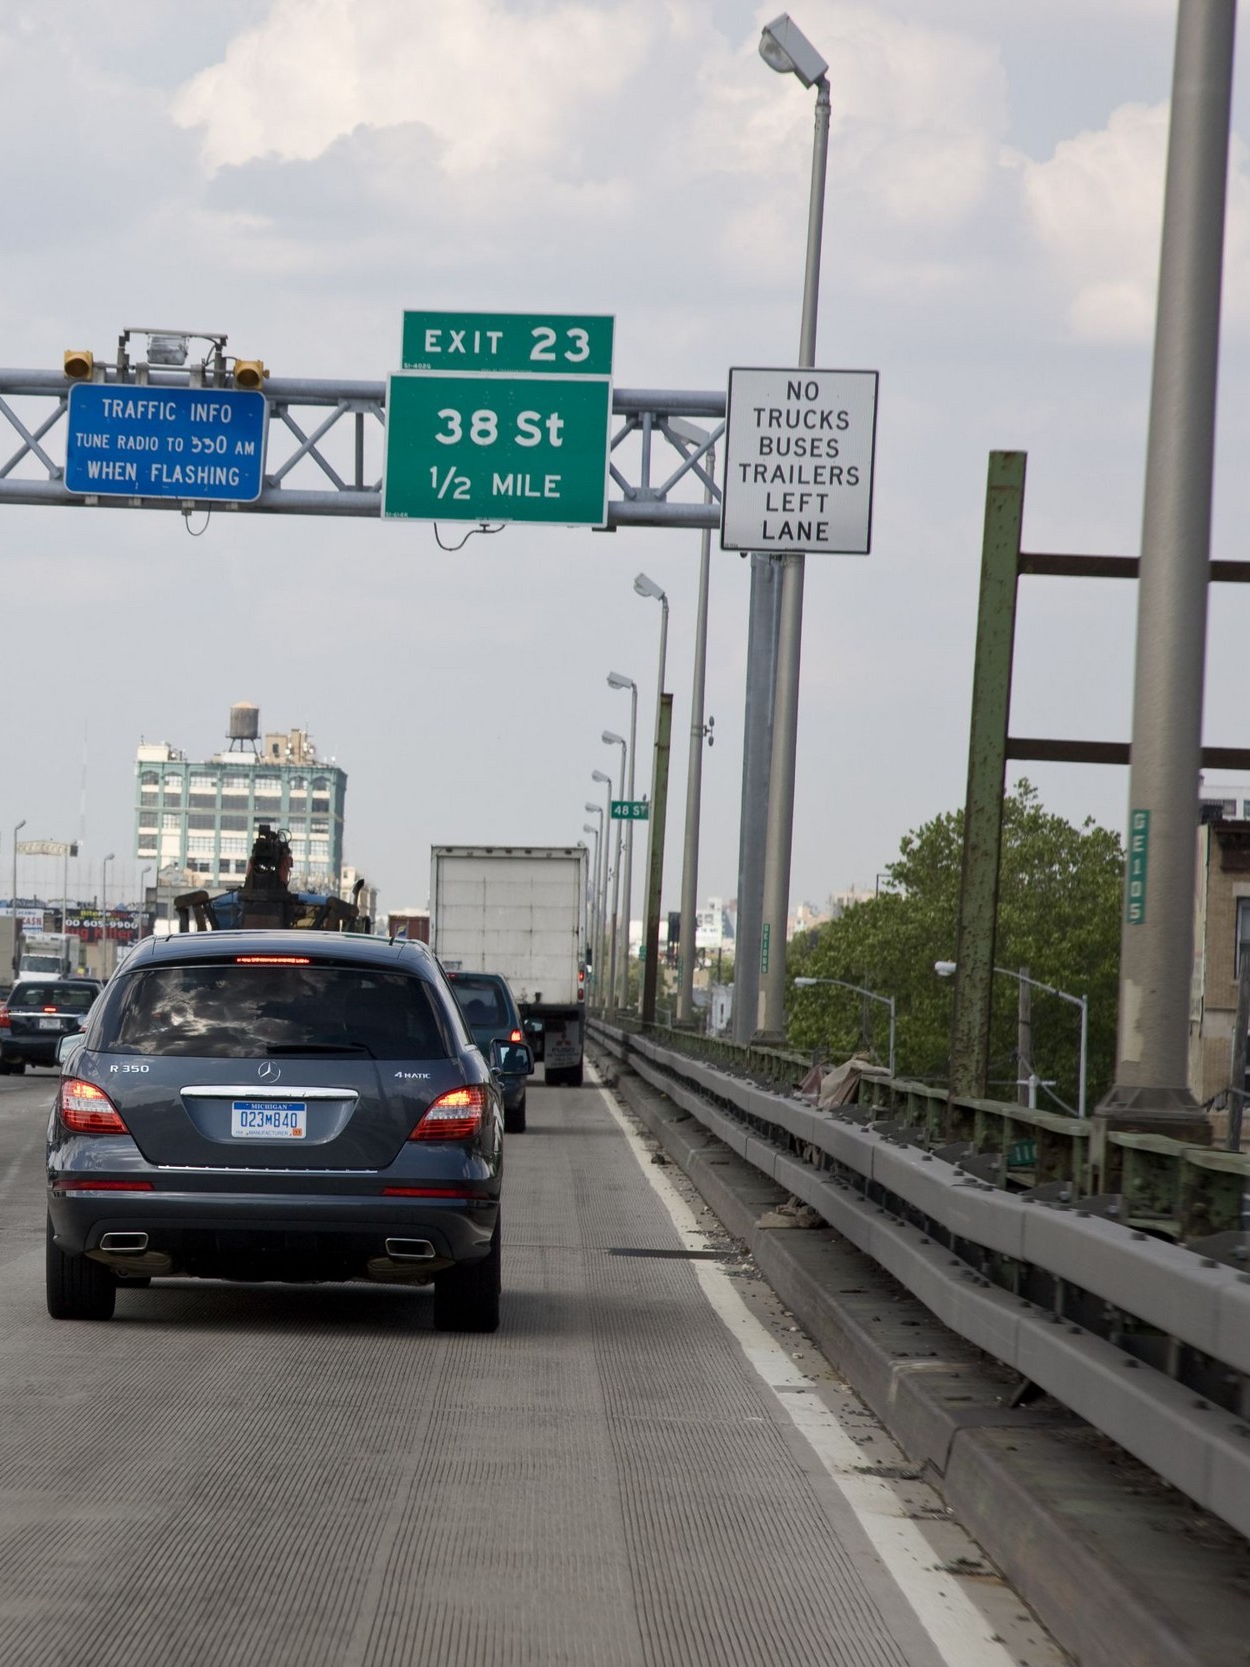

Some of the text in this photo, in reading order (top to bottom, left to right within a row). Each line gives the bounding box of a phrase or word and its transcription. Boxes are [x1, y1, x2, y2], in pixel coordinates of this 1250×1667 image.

[424, 326, 591, 362] EXIT 23
[787, 380, 819, 402] NO
[102, 399, 232, 424] TRAFFIC INFO
[753, 408, 850, 431] TRUCKS
[434, 408, 564, 447] 38 St
[76, 433, 110, 449] TUNE
[117, 434, 159, 451] RADIO
[167, 437, 183, 452] TO
[235, 440, 255, 456] AM
[759, 436, 839, 459] BUSES
[87, 460, 240, 486] WHEN FLASHING
[430, 465, 561, 500] 1/2 MILE
[739, 463, 860, 486] TRAILERS
[766, 492, 829, 513] LEFT
[762, 520, 829, 542] LANE
[614, 805, 646, 816] 48 ST
[110, 1065, 150, 1073] R 350
